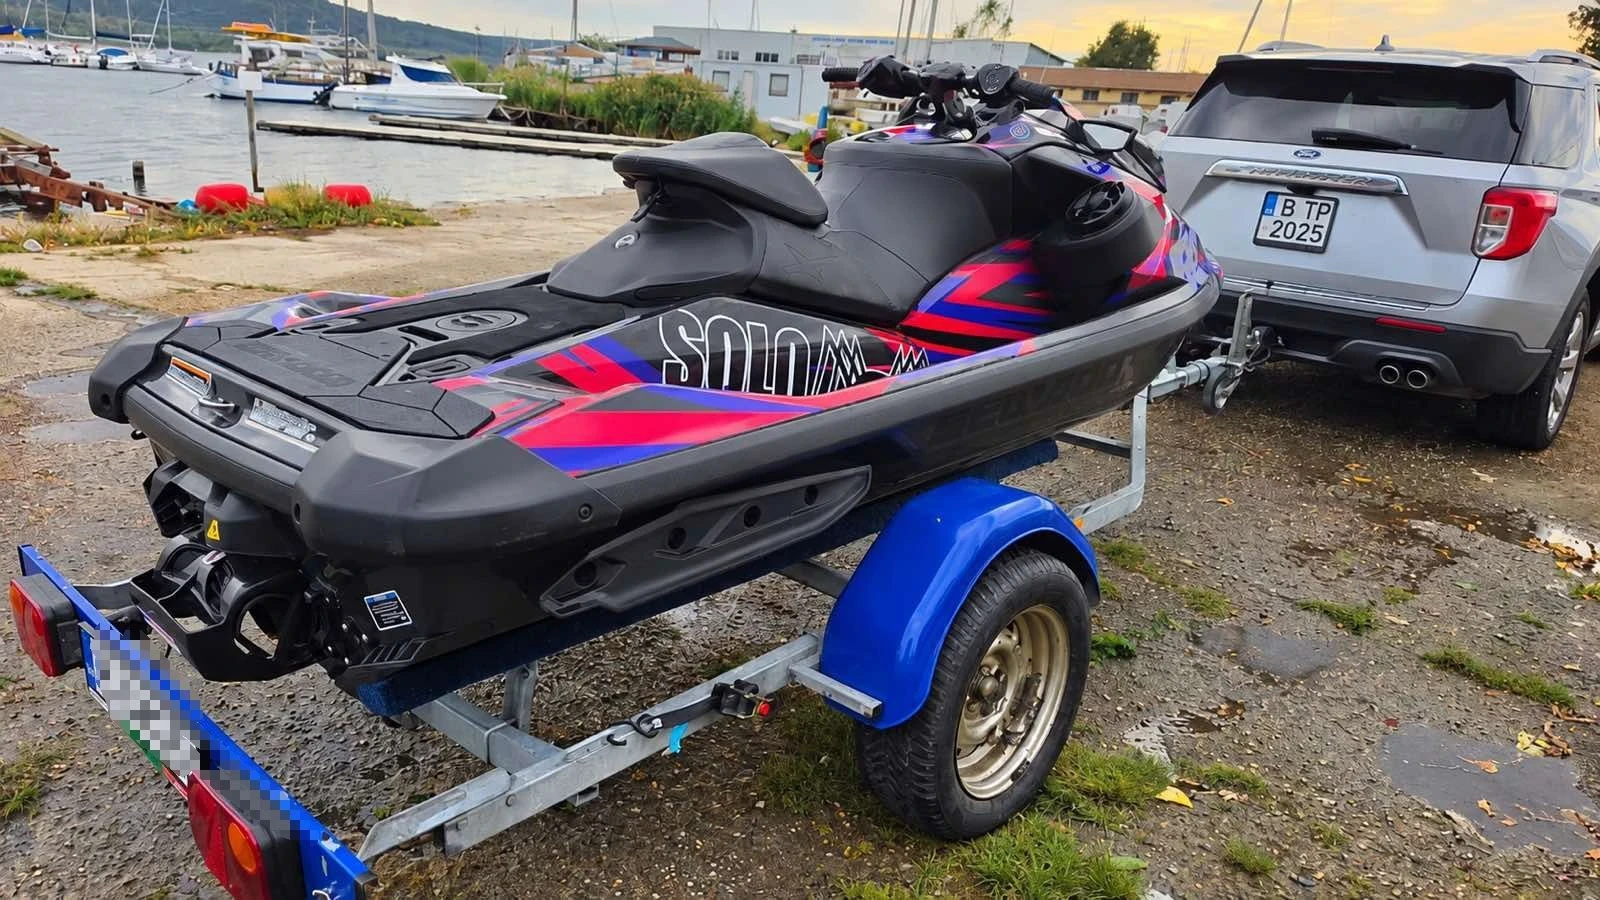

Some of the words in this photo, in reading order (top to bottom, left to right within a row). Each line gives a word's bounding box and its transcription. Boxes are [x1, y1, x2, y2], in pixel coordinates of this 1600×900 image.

[1281, 198, 1296, 217] B
[1305, 200, 1331, 221] TP
[1269, 219, 1324, 243] 2025
